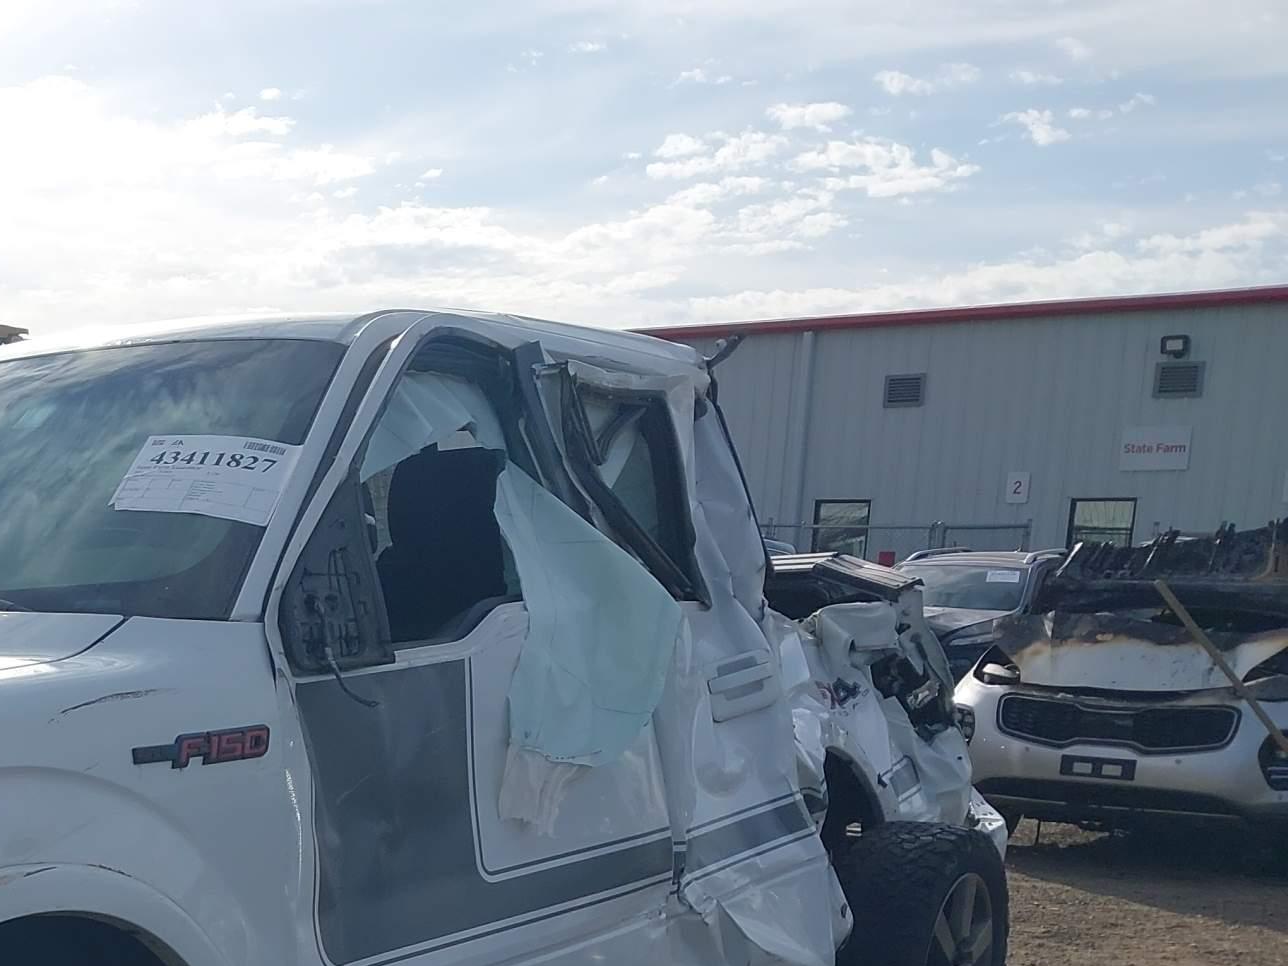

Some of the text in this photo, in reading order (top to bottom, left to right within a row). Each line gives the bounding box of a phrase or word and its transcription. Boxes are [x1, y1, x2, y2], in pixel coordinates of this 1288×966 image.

[1123, 442, 1187, 454] State Farm
[149, 450, 278, 473] 43411827
[1012, 480, 1023, 495] 2
